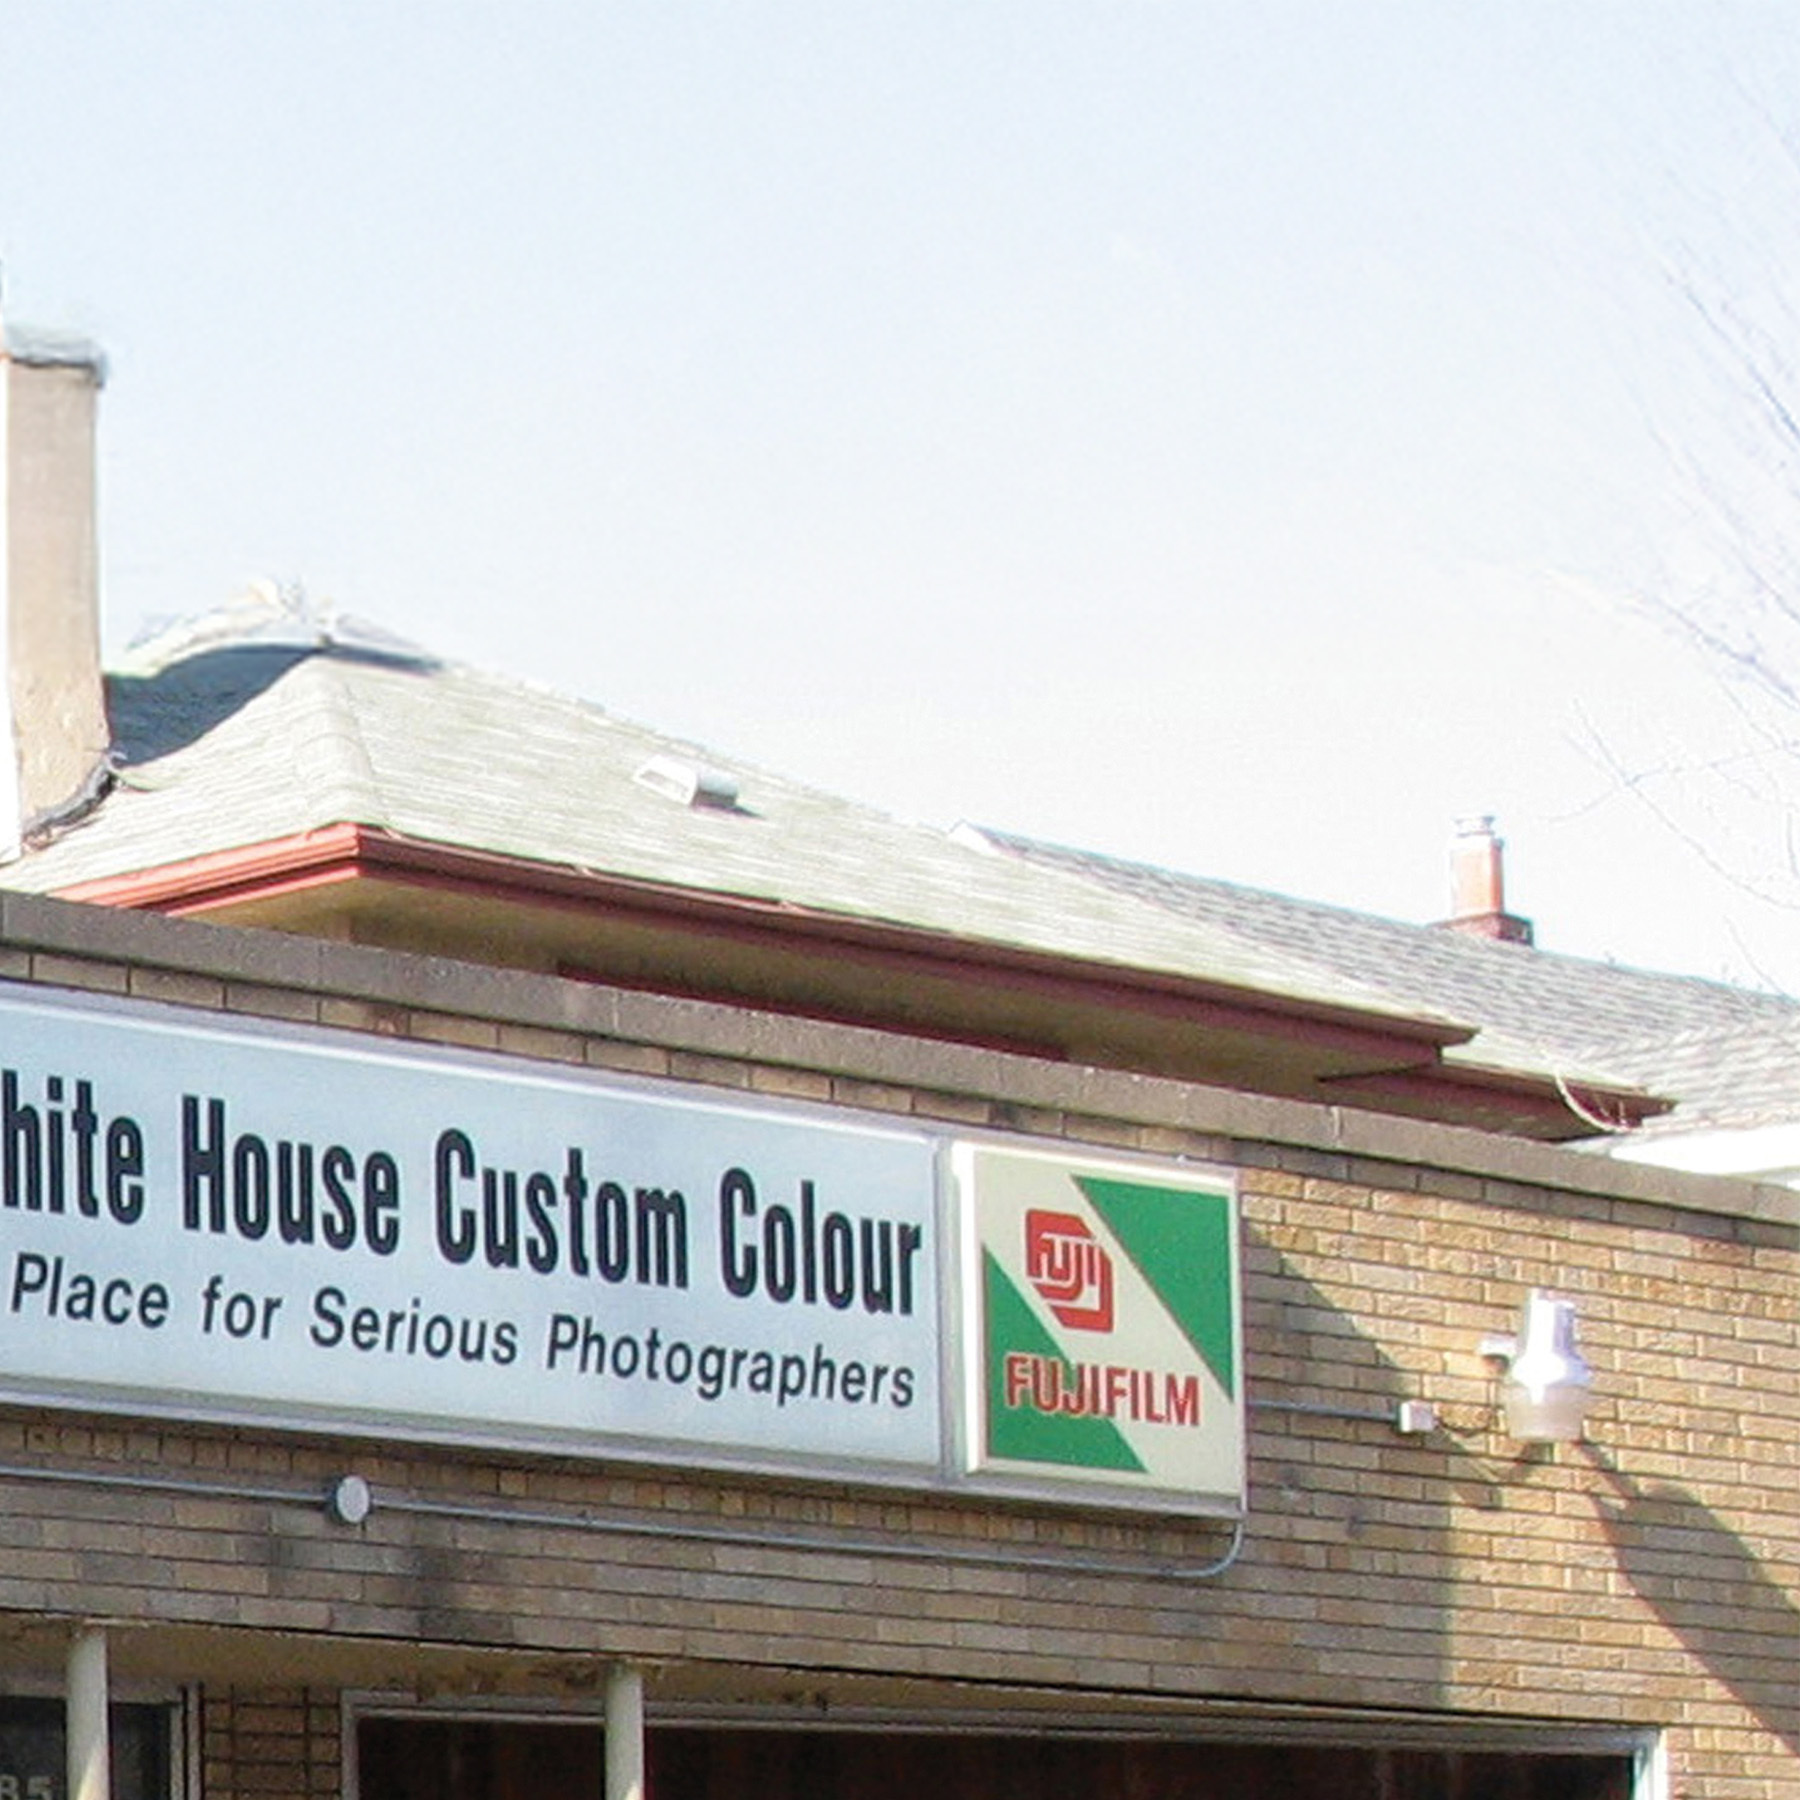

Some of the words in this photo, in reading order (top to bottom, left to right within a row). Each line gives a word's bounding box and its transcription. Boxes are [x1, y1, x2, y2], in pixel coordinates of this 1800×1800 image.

[181, 1093, 401, 1257] House
[434, 1128, 690, 1290] Custom
[719, 1166, 923, 1316] Colour
[1026, 1208, 1114, 1333] FUJI
[10, 1251, 170, 1329] Place
[202, 1275, 283, 1341] for
[309, 1285, 519, 1366] Serious
[546, 1312, 916, 1409] Photographers
[1005, 1353, 1201, 1429] FUJIFILM
